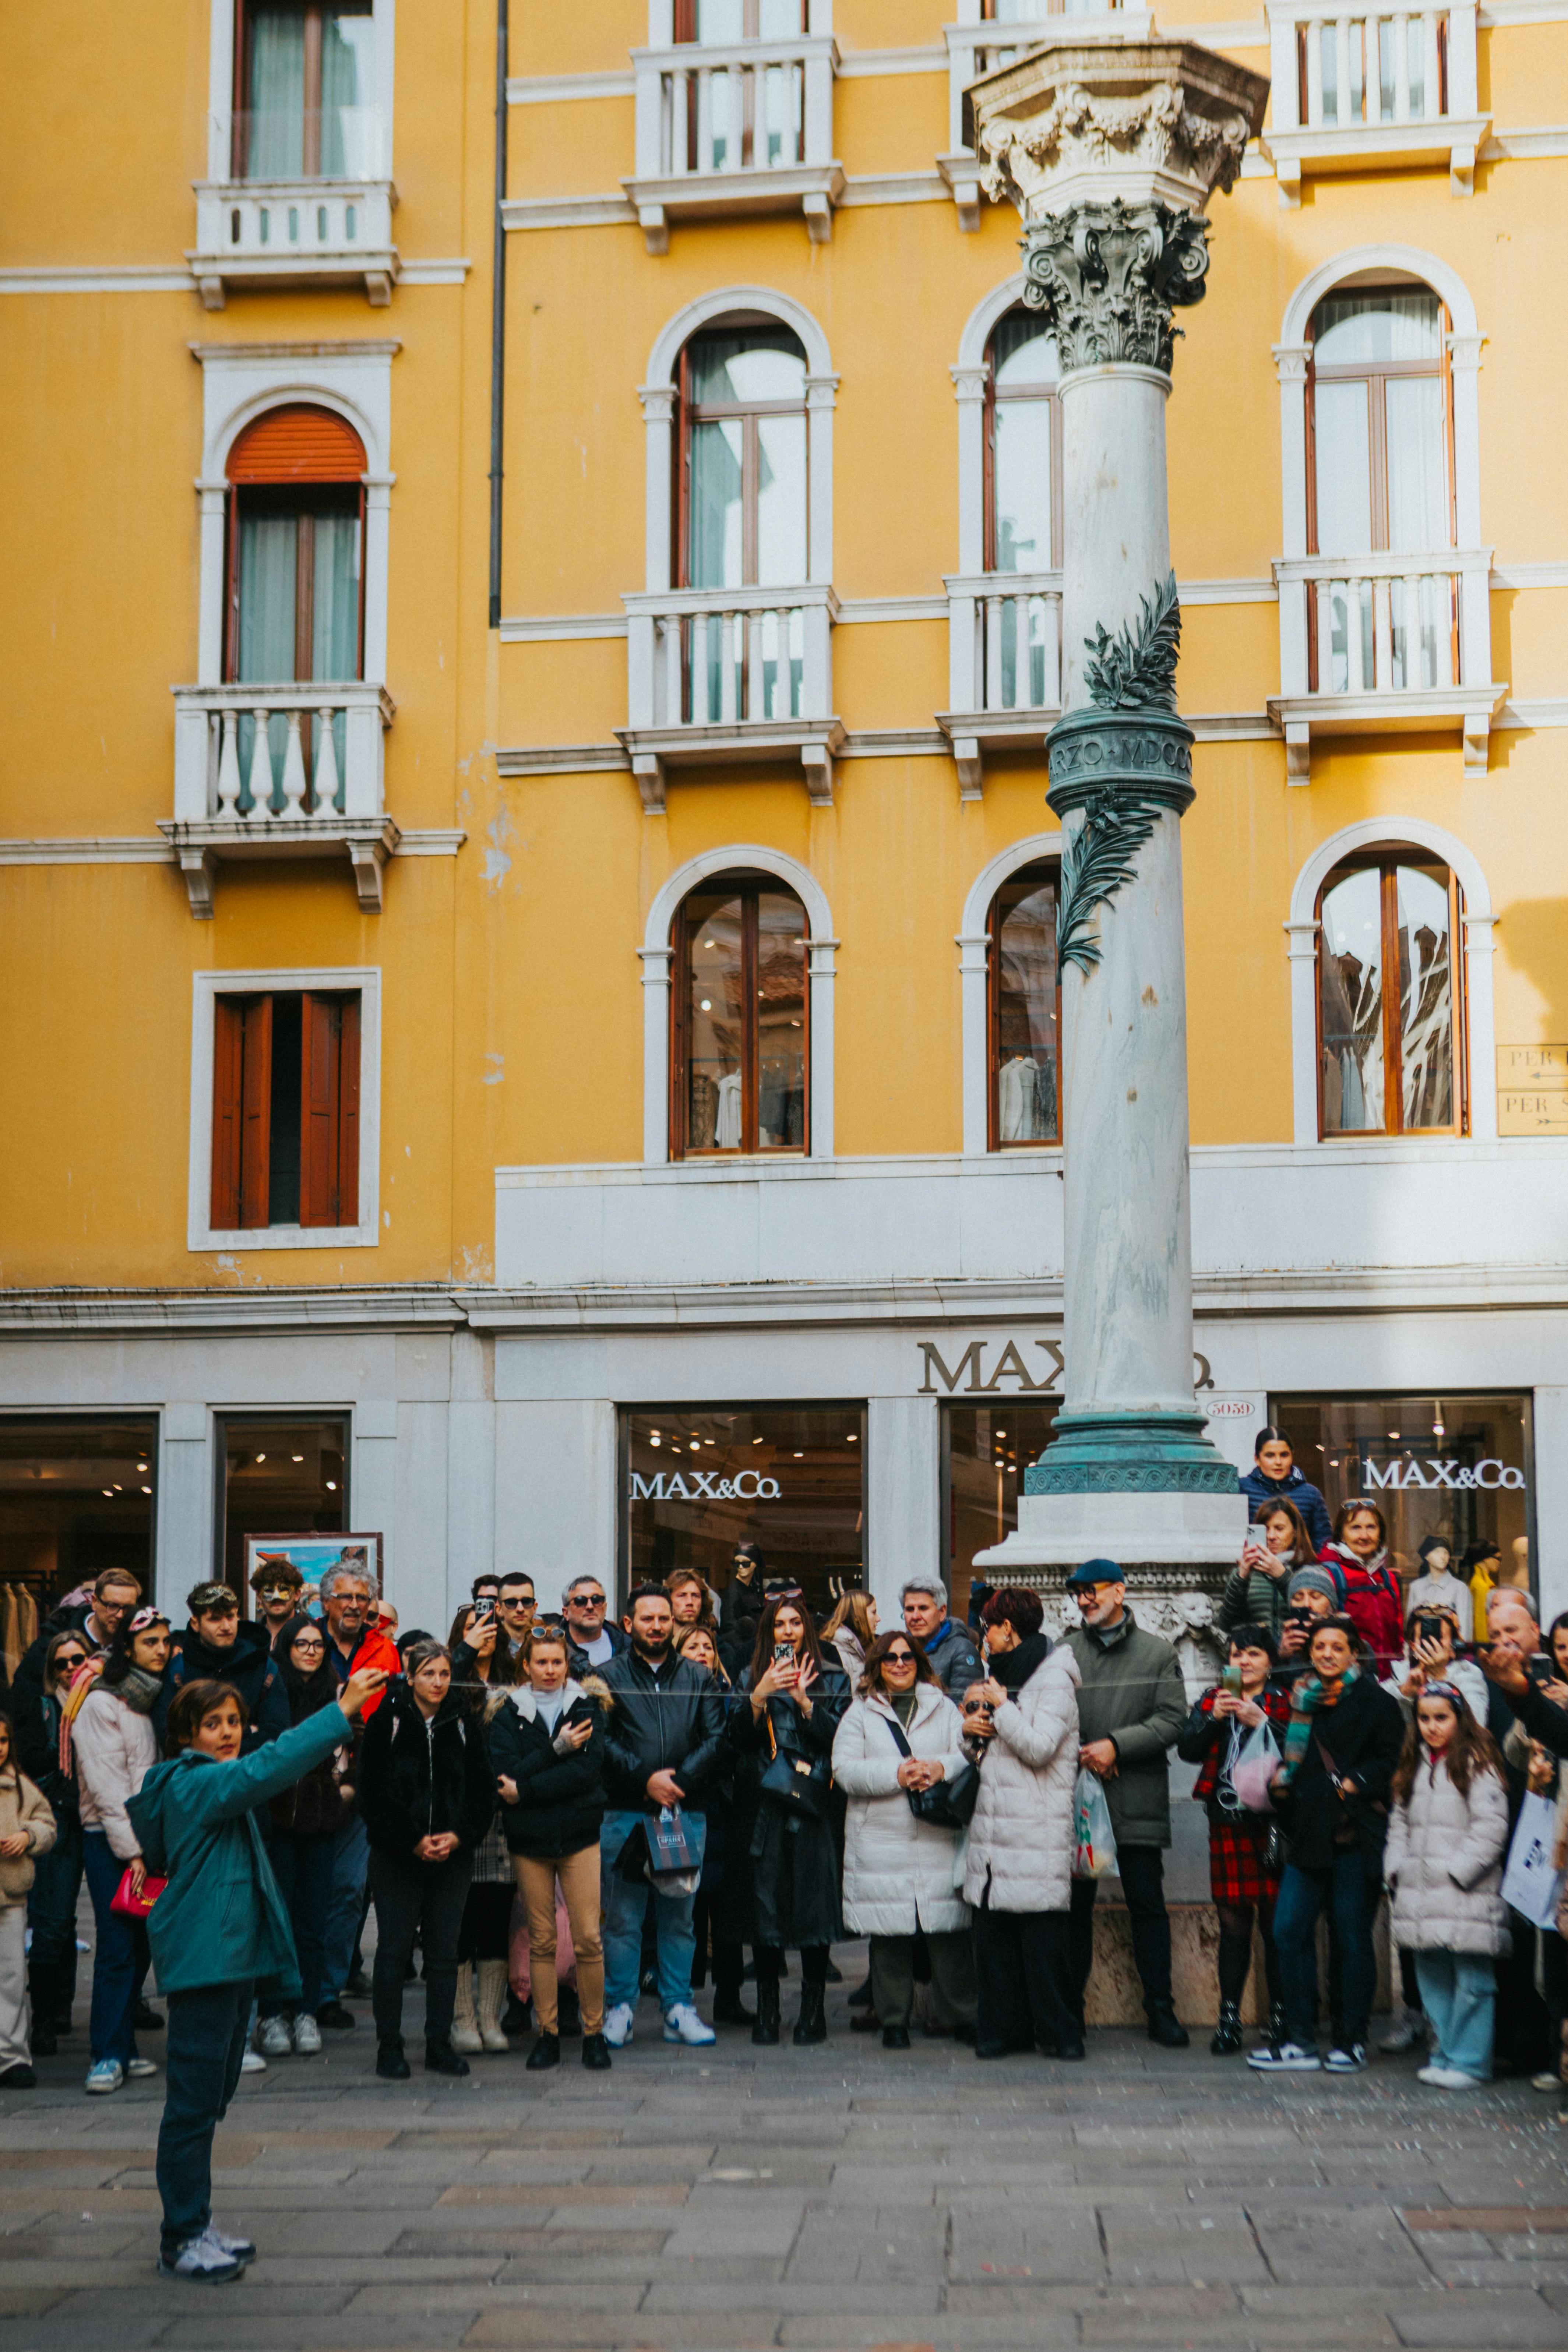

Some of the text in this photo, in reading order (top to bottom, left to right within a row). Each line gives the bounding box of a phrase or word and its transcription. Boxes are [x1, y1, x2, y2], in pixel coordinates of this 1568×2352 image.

[1511, 1051, 1551, 1066] PER
[1507, 1098, 1547, 1113] PER
[1212, 1403, 1250, 1414] 5059
[1362, 1459, 1526, 1489] MAX&Co.
[630, 1470, 782, 1499] MAX&Co.
